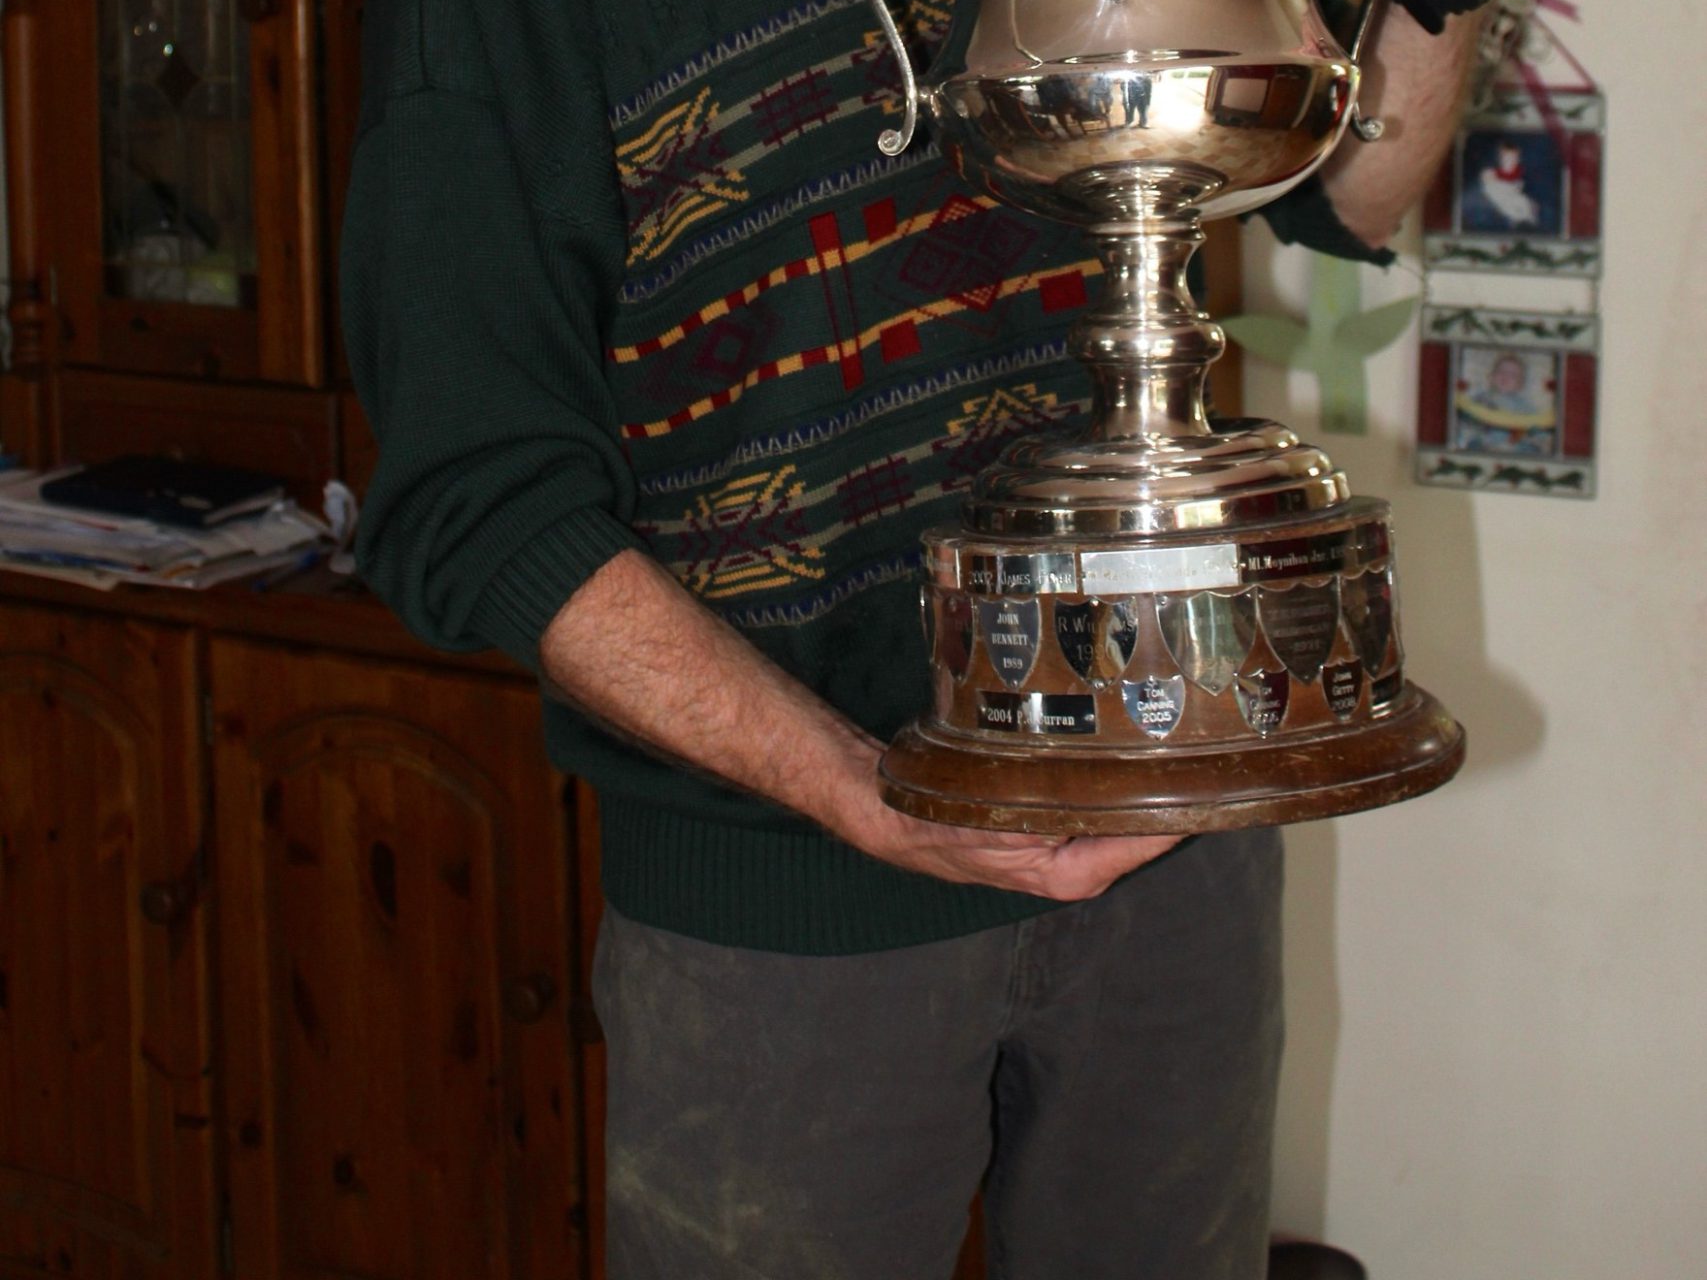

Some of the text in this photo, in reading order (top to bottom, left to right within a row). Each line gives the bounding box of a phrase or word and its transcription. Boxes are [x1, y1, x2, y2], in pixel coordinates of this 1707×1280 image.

[1001, 570, 1031, 587] JAMES
[997, 613, 1020, 626] JOHN
[1058, 616, 1068, 633] R
[991, 633, 1028, 646] BENNETT
[1003, 657, 1024, 669] 1989
[1144, 688, 1165, 698] TOM
[987, 708, 1013, 722] 2004
[1142, 711, 1172, 723] 2005
